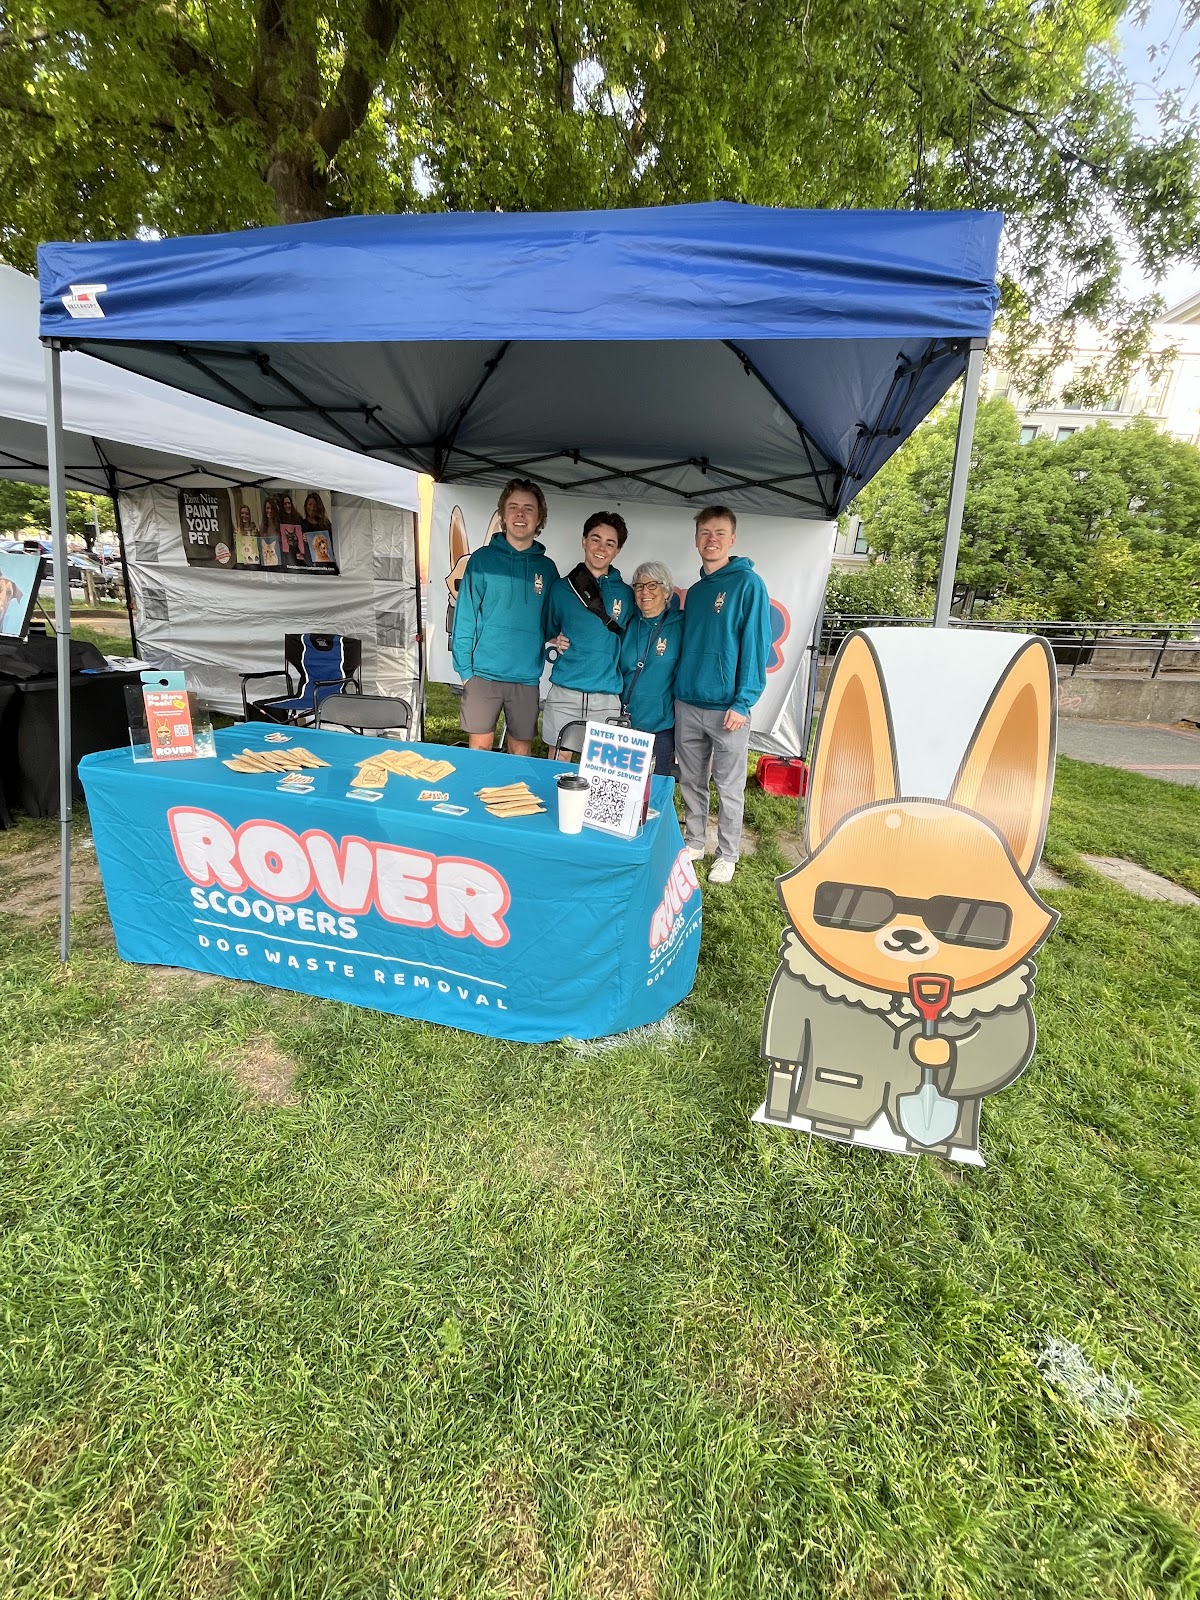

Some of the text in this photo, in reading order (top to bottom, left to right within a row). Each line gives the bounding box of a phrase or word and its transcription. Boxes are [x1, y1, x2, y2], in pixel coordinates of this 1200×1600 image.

[183, 493, 218, 504] Paint Nite
[185, 505, 219, 518] PAINT
[186, 518, 220, 532] YOUR
[188, 531, 210, 545] PET
[590, 728, 650, 748] ENTER TO WIN
[155, 745, 193, 756] ROVER
[587, 739, 647, 774] FREE
[585, 763, 606, 774] MONTH
[616, 771, 643, 783] SERVICE
[167, 806, 511, 948] ROVER
[649, 848, 700, 948] ROVER
[190, 886, 358, 939] SCOOPERS
[198, 934, 508, 1010] DOG WASTE REMOVAL
